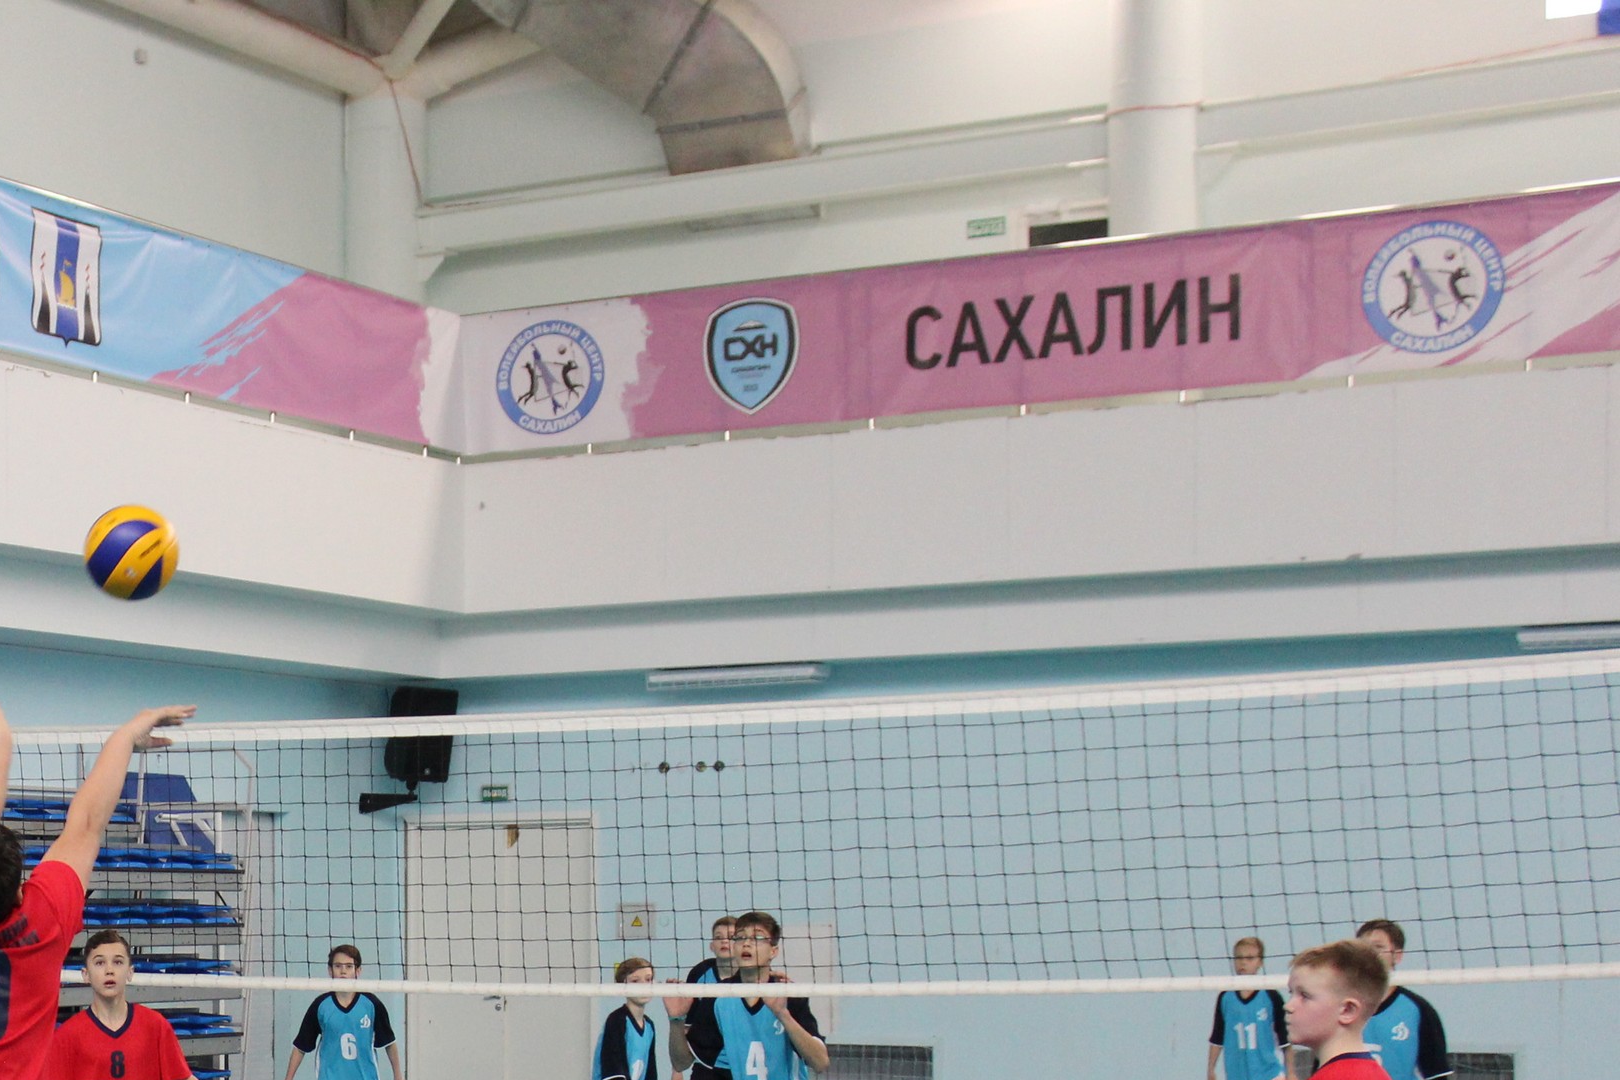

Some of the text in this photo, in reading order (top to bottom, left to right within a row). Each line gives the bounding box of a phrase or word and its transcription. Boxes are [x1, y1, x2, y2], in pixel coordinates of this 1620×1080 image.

[905, 273, 1242, 371] САХАЛИН
[519, 410, 582, 433] САХАЛИН
[340, 1033, 358, 1060] 6
[1233, 1022, 1258, 1050] 11
[110, 1050, 125, 1079] 8
